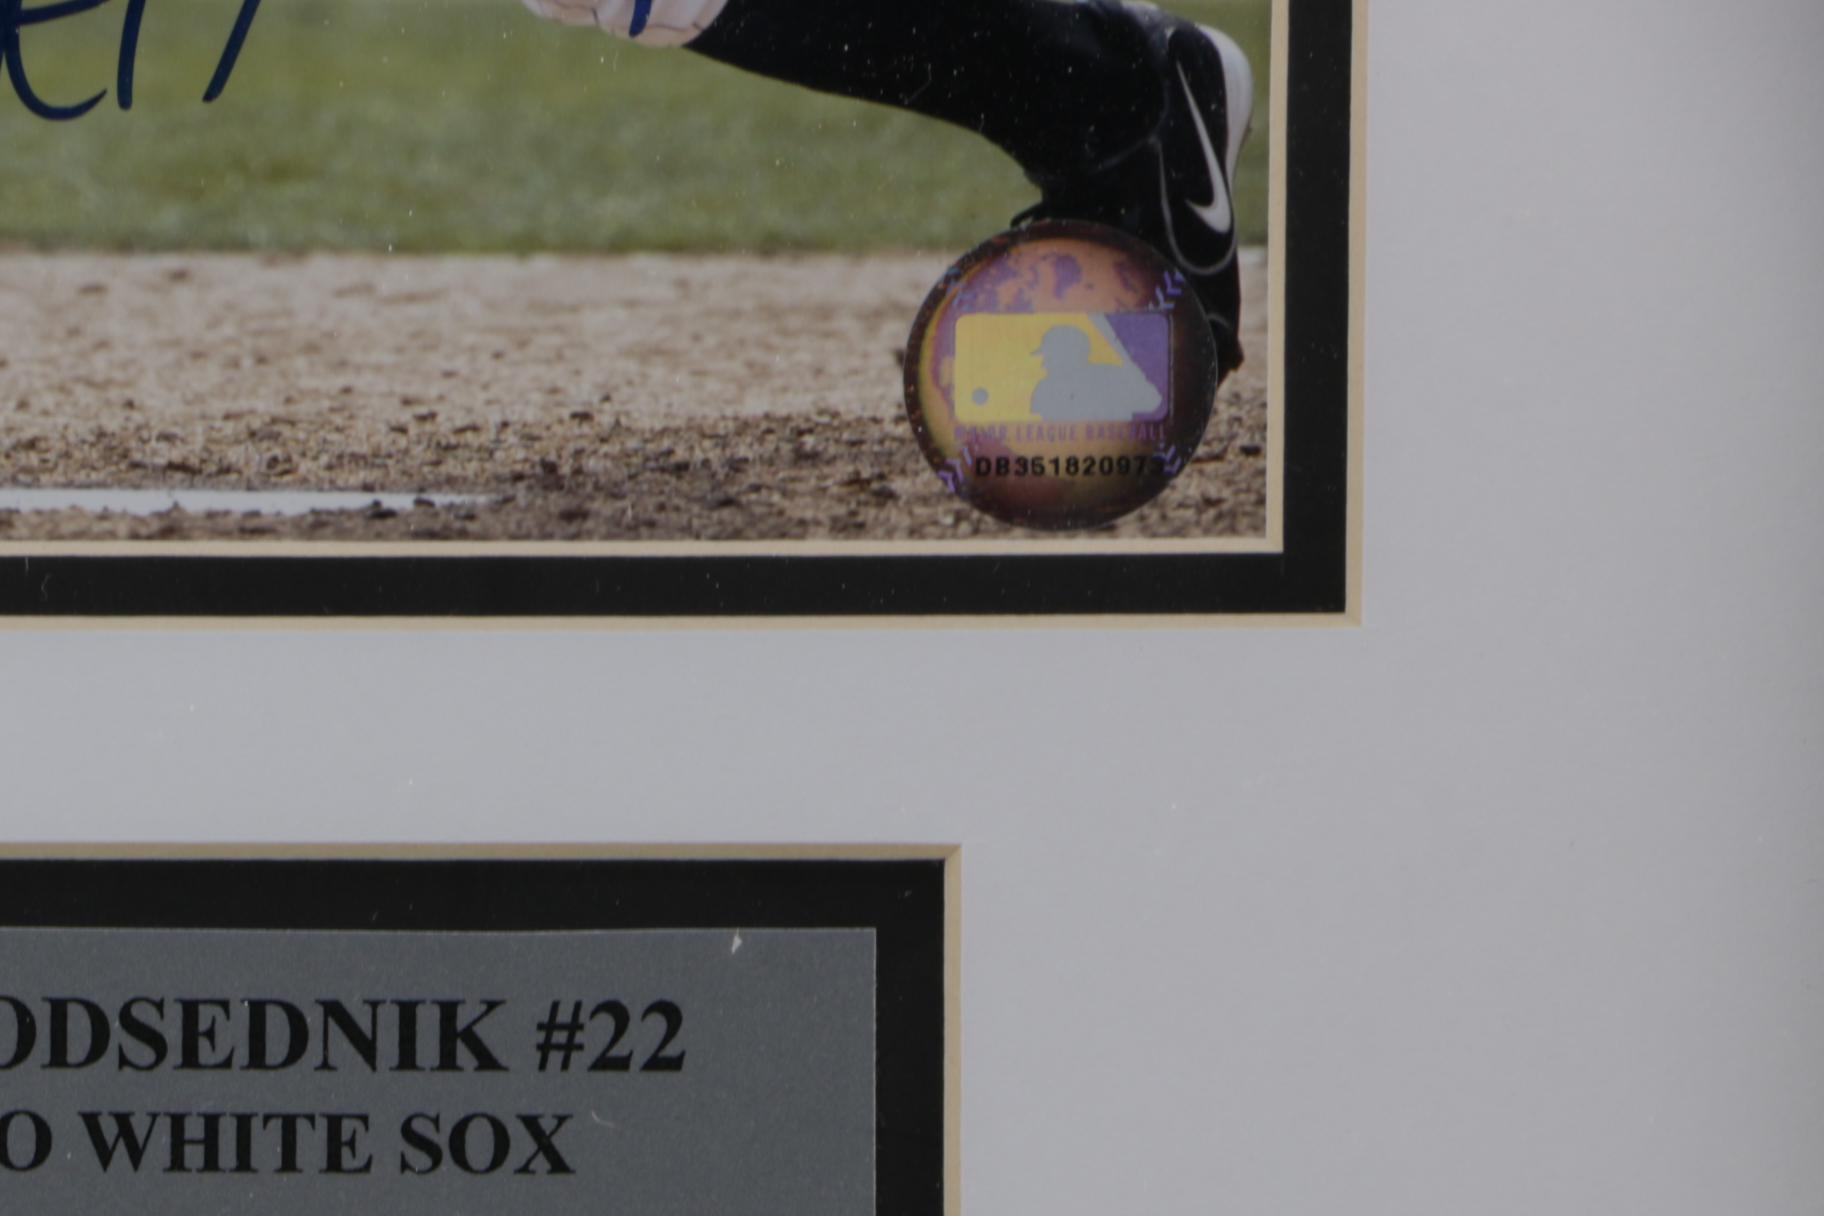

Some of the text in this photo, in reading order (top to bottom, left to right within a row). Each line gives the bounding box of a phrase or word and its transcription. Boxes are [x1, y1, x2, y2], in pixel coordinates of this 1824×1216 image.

[1015, 424, 1078, 442] LEAGUE
[533, 997, 687, 1077] #22
[76, 1107, 374, 1178] WHITE
[398, 1109, 577, 1180] SOX
